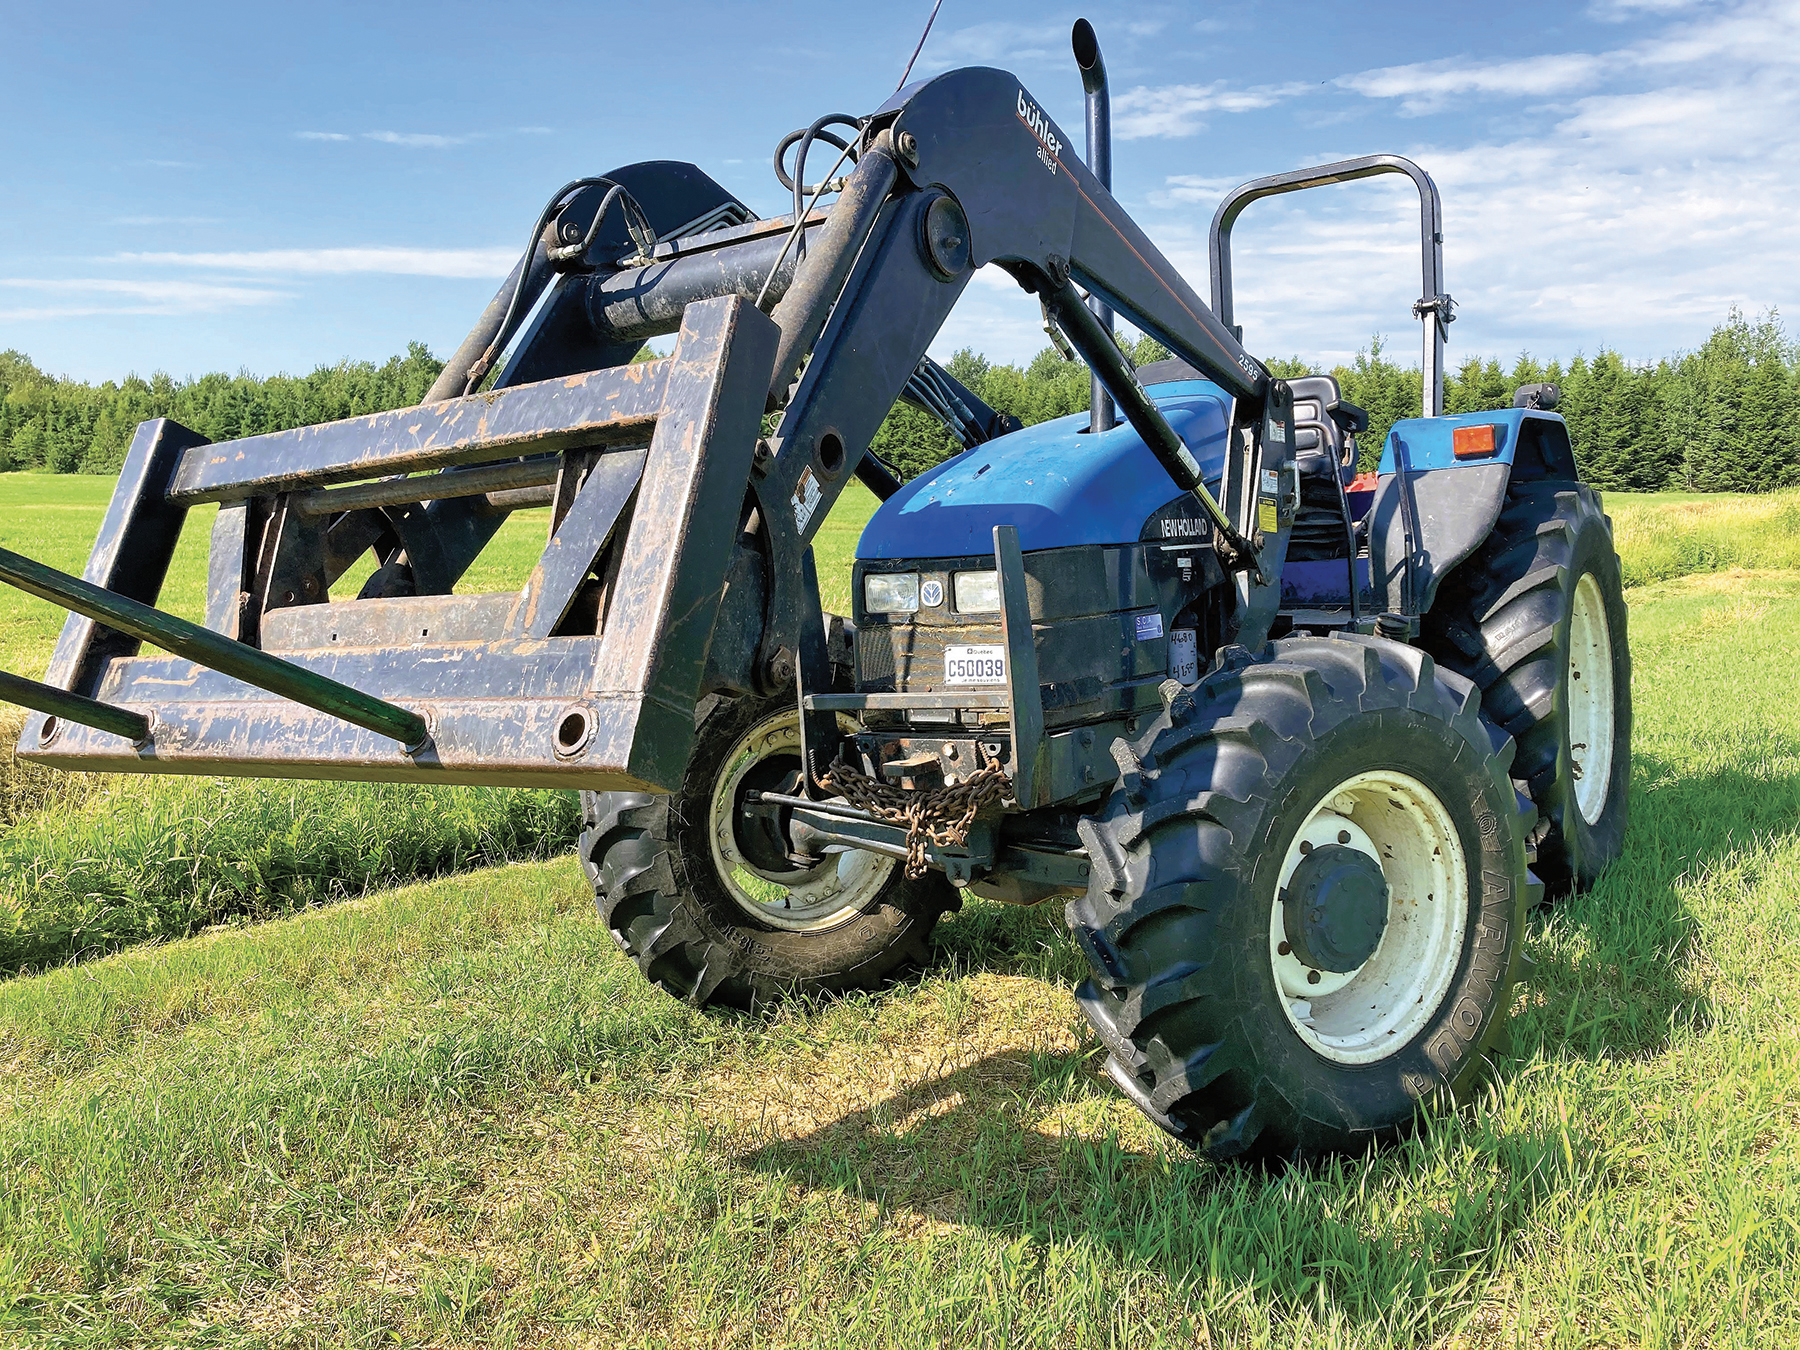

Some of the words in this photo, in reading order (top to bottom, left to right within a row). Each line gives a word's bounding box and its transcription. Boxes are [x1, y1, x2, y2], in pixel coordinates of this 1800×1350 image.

[1017, 88, 1063, 157] bühler
[1036, 146, 1058, 176] allied
[1238, 354, 1259, 381] 2595
[1160, 519, 1177, 537] NEW
[1177, 518, 1208, 536] HOLLAND
[948, 659, 1003, 677] C50039
